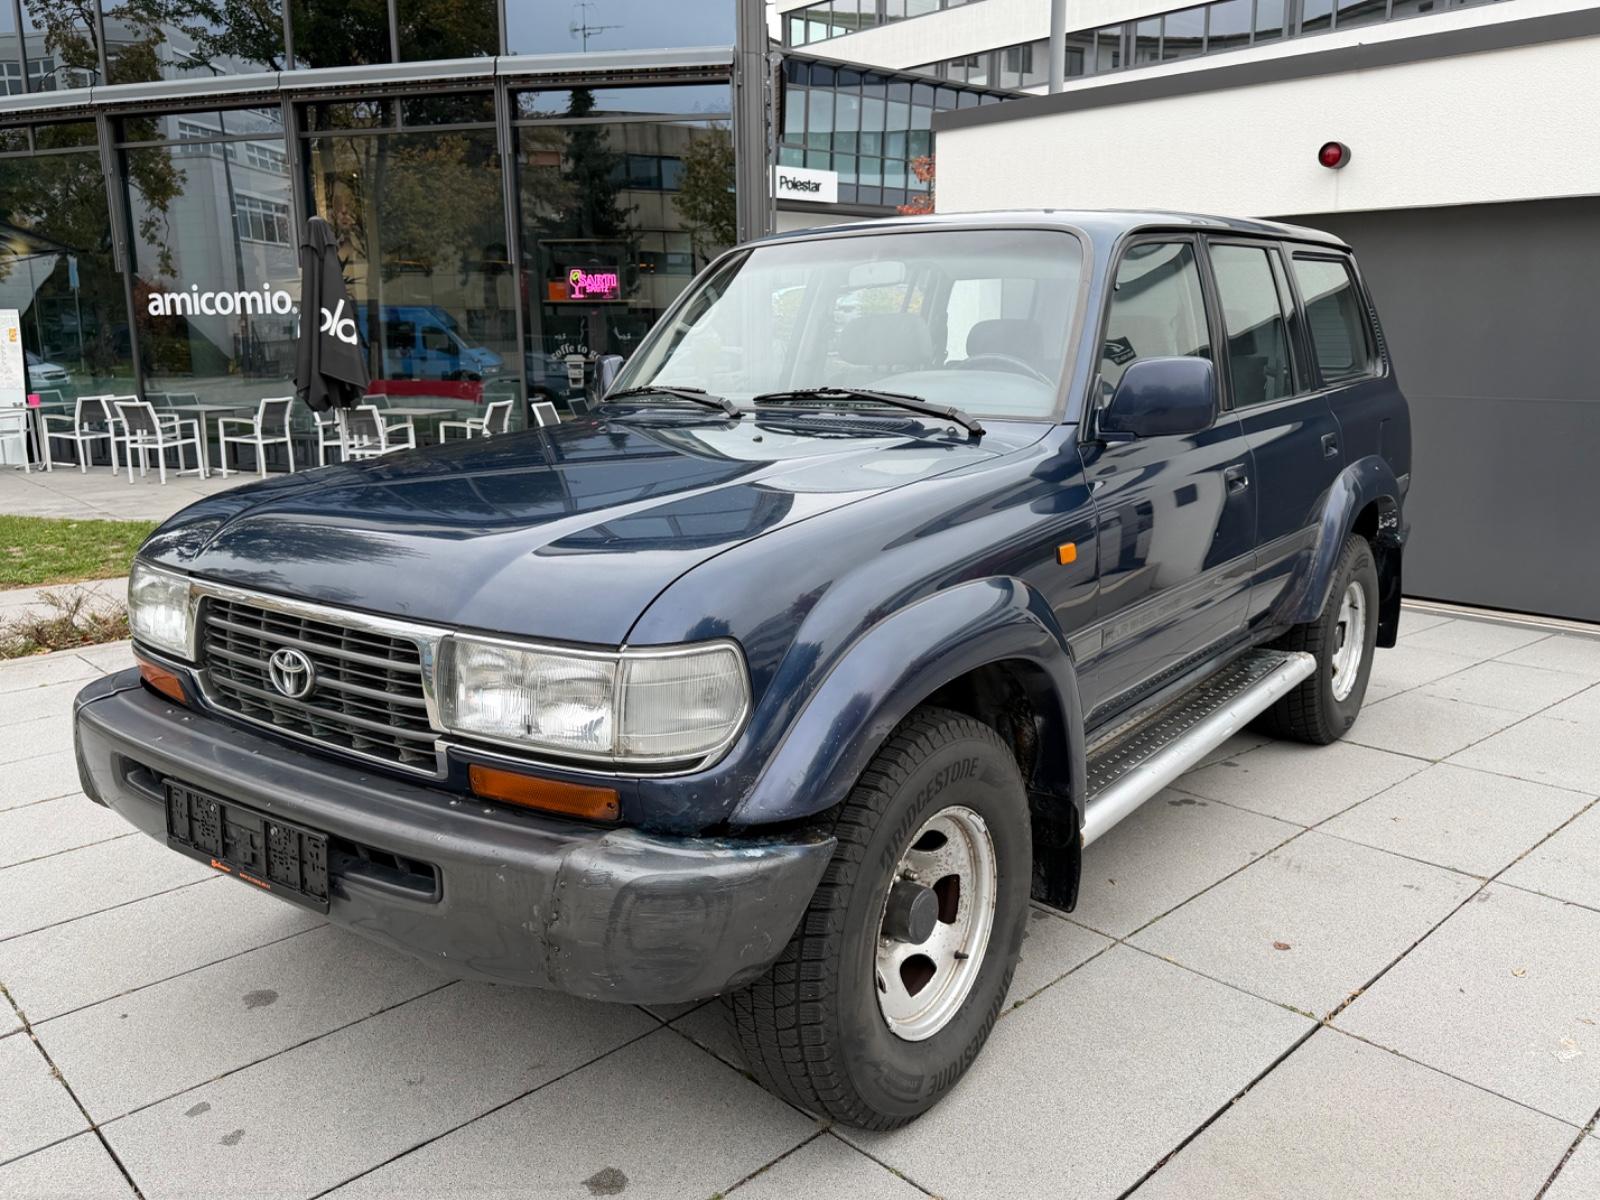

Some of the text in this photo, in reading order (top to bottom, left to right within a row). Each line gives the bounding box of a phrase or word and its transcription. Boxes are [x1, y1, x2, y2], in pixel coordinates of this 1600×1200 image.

[779, 175, 822, 193] Polestar
[577, 343, 588, 354] to
[879, 757, 979, 872] BRIDGESTONE
